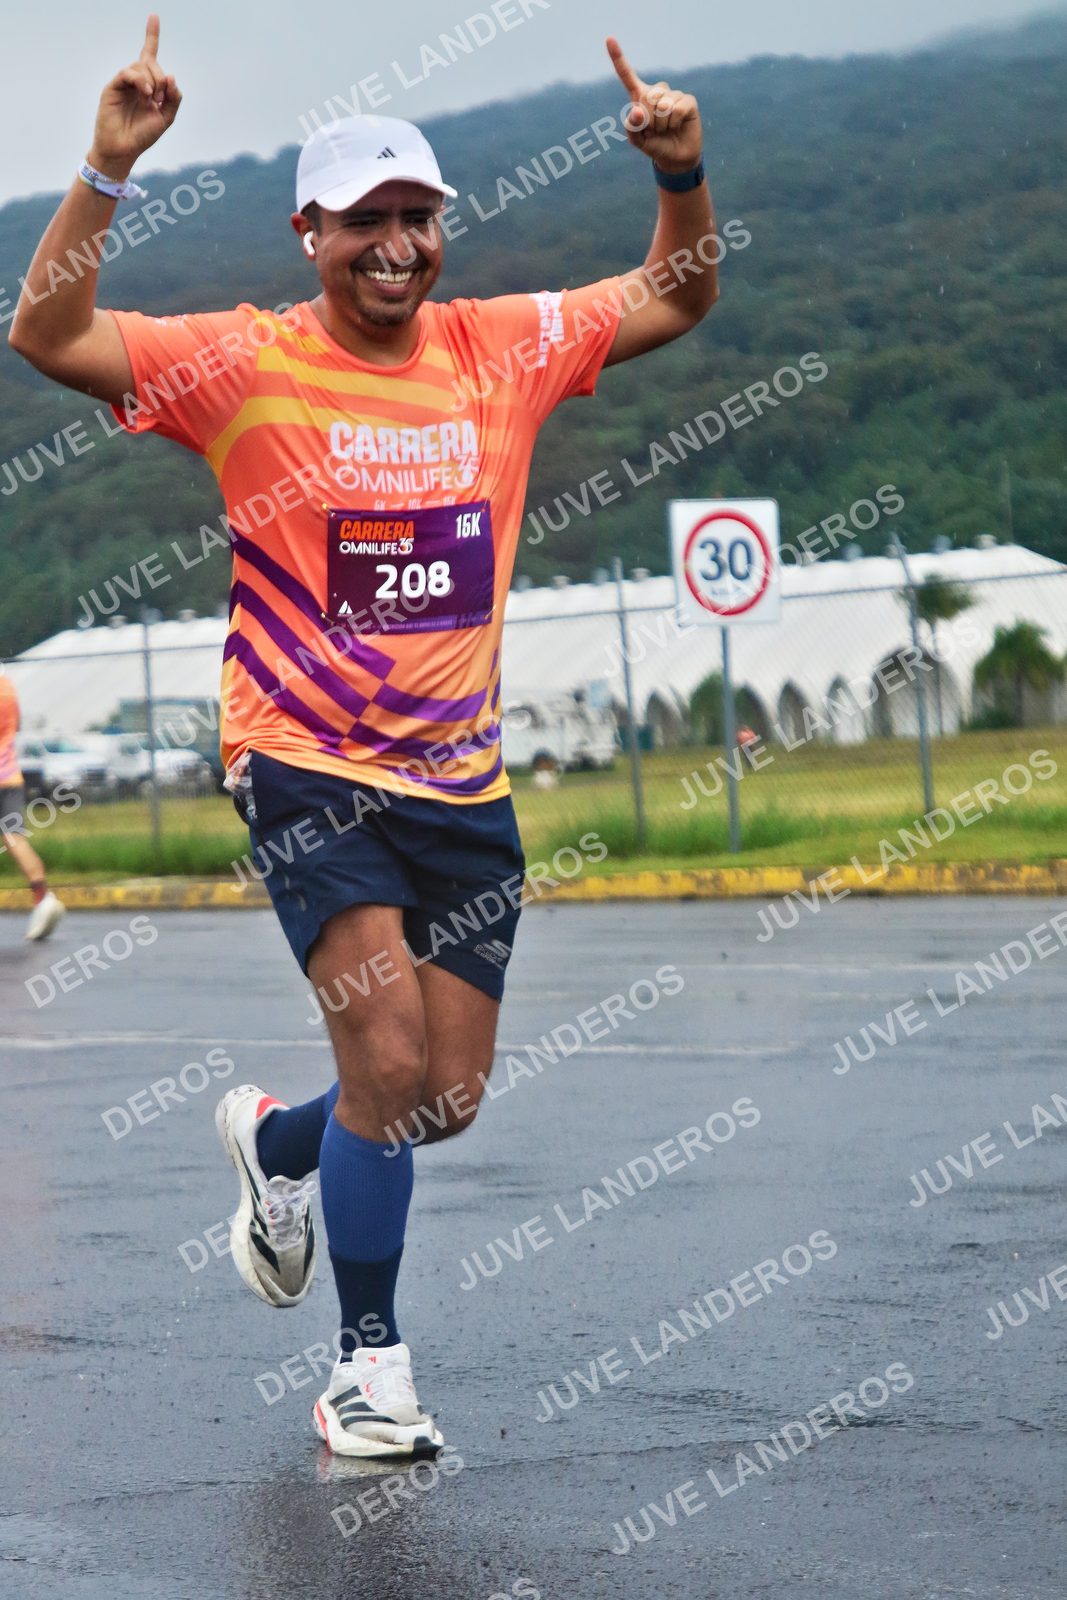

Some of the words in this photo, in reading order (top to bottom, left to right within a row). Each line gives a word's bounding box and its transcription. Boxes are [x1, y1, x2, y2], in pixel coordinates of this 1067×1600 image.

[330, 420, 479, 464] CARRERA
[335, 465, 453, 494] OMNILIFE
[340, 520, 415, 540] CARRERA
[456, 512, 481, 539] 15K
[339, 541, 398, 555] OMNILIFE
[699, 538, 754, 582] 30
[375, 561, 451, 600] 208
